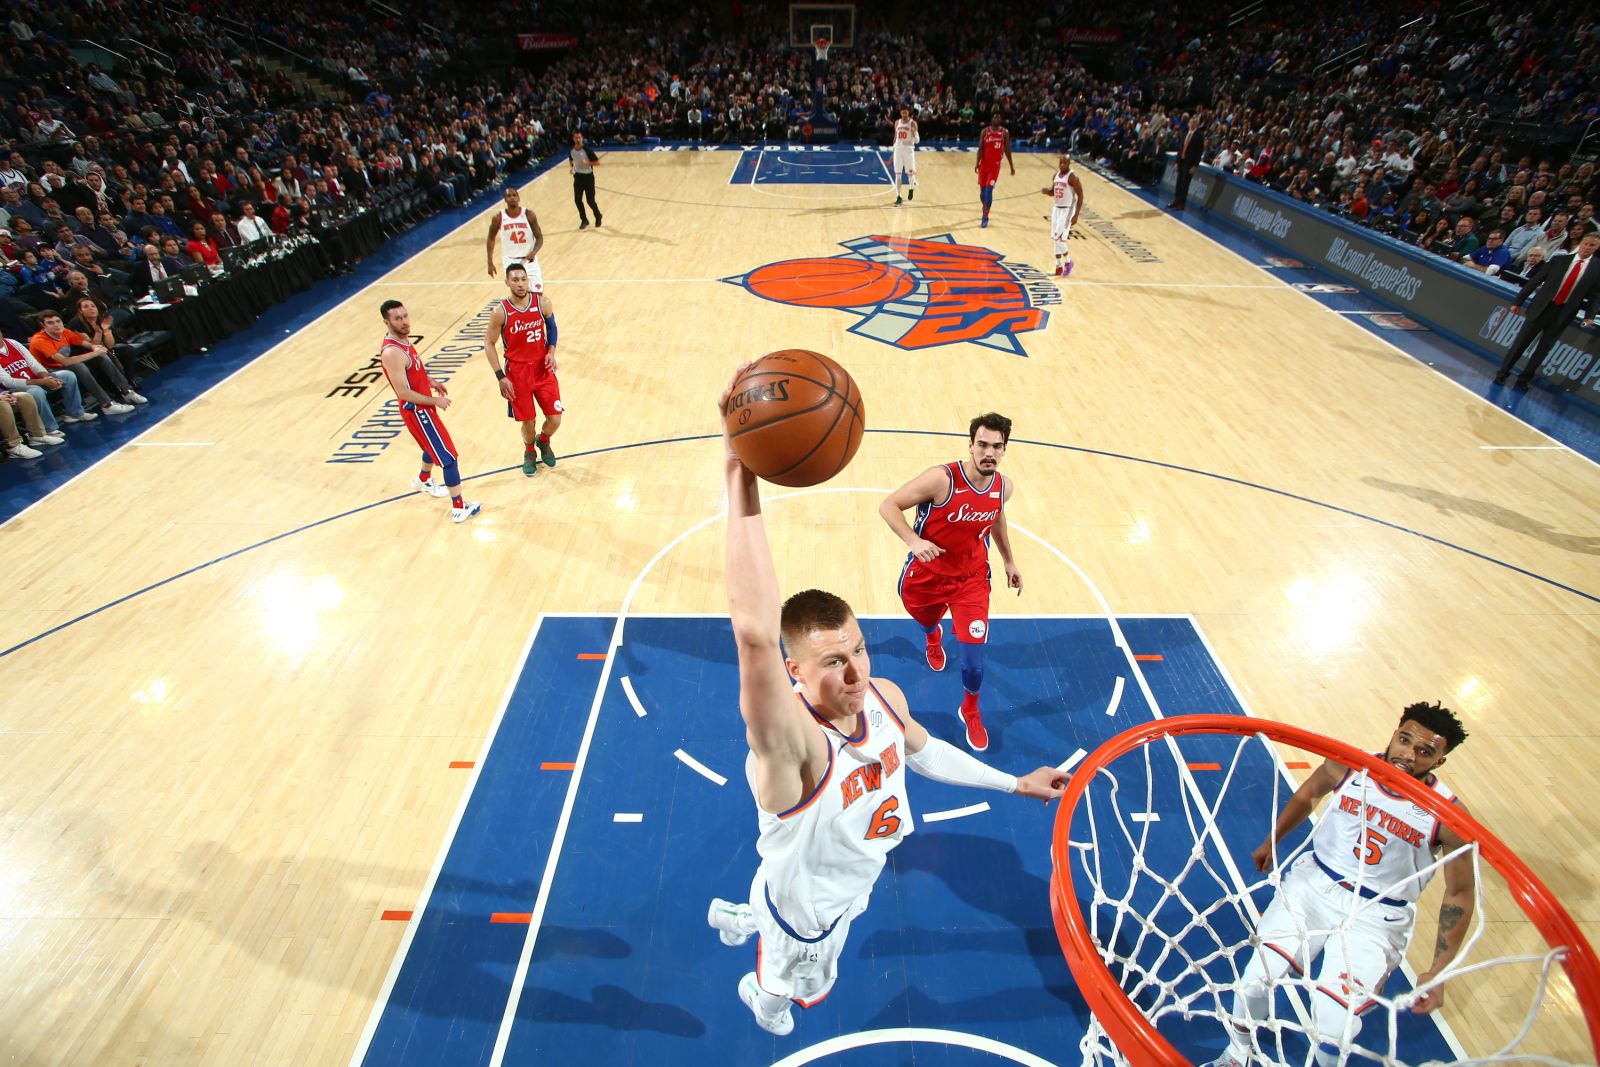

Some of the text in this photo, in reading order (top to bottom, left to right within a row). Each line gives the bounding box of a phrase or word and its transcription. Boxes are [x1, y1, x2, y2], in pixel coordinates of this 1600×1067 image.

[522, 36, 569, 50] Budweiser
[510, 231, 526, 244] 42
[1325, 237, 1422, 301] NBA.com/LeaguePass
[1025, 282, 1062, 306] YORK
[510, 319, 542, 334] Sixers
[526, 329, 541, 343] 25
[5, 359, 29, 374] SIXER
[726, 379, 790, 415] SPALDIN
[947, 503, 998, 523] Sixers
[840, 762, 882, 810] NEW
[864, 795, 901, 840] 6
[1338, 795, 1426, 849] NEW YORK
[1353, 828, 1387, 865] 5
